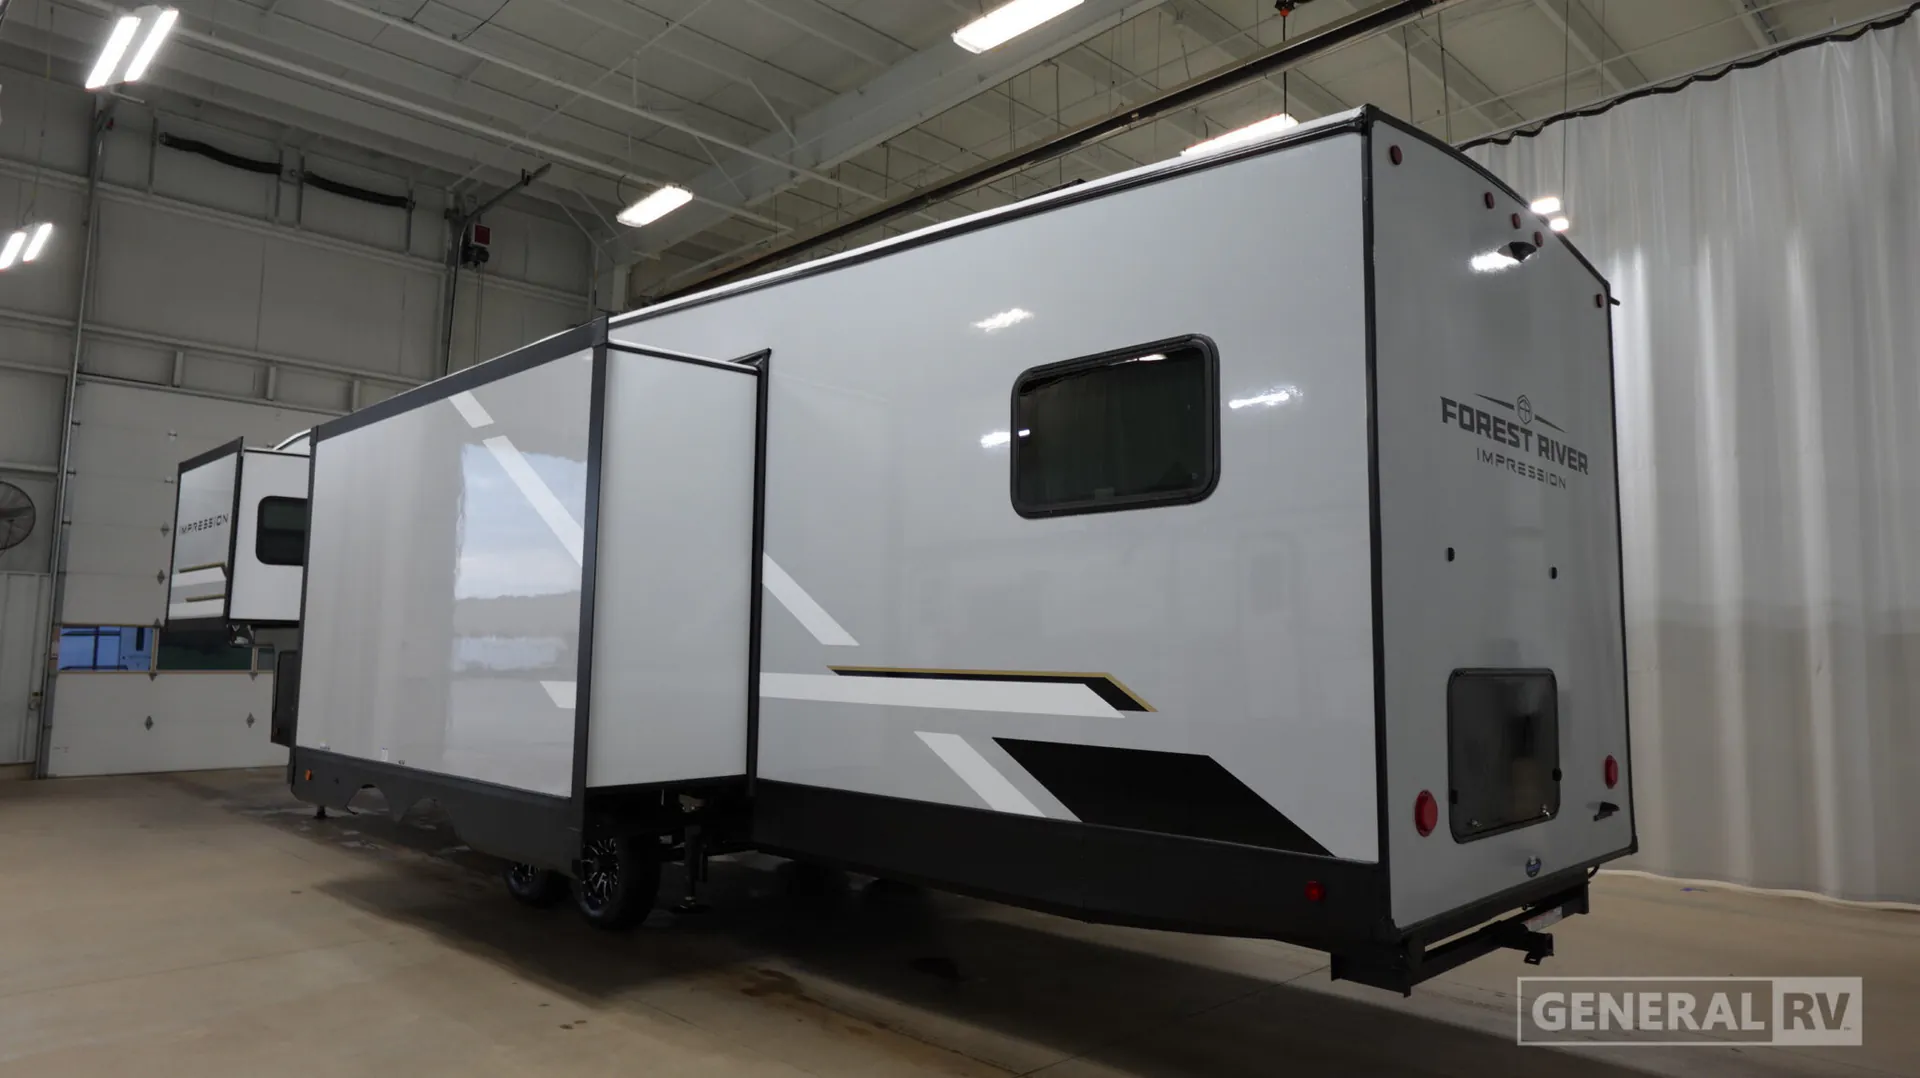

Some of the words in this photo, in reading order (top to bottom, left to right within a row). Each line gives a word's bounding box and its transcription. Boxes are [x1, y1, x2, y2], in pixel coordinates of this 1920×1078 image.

[1440, 396, 1533, 452] FOREST
[1537, 433, 1589, 475] RIVER
[1476, 447, 1567, 490] IMPRESSION
[179, 513, 230, 535] IMPRESSION
